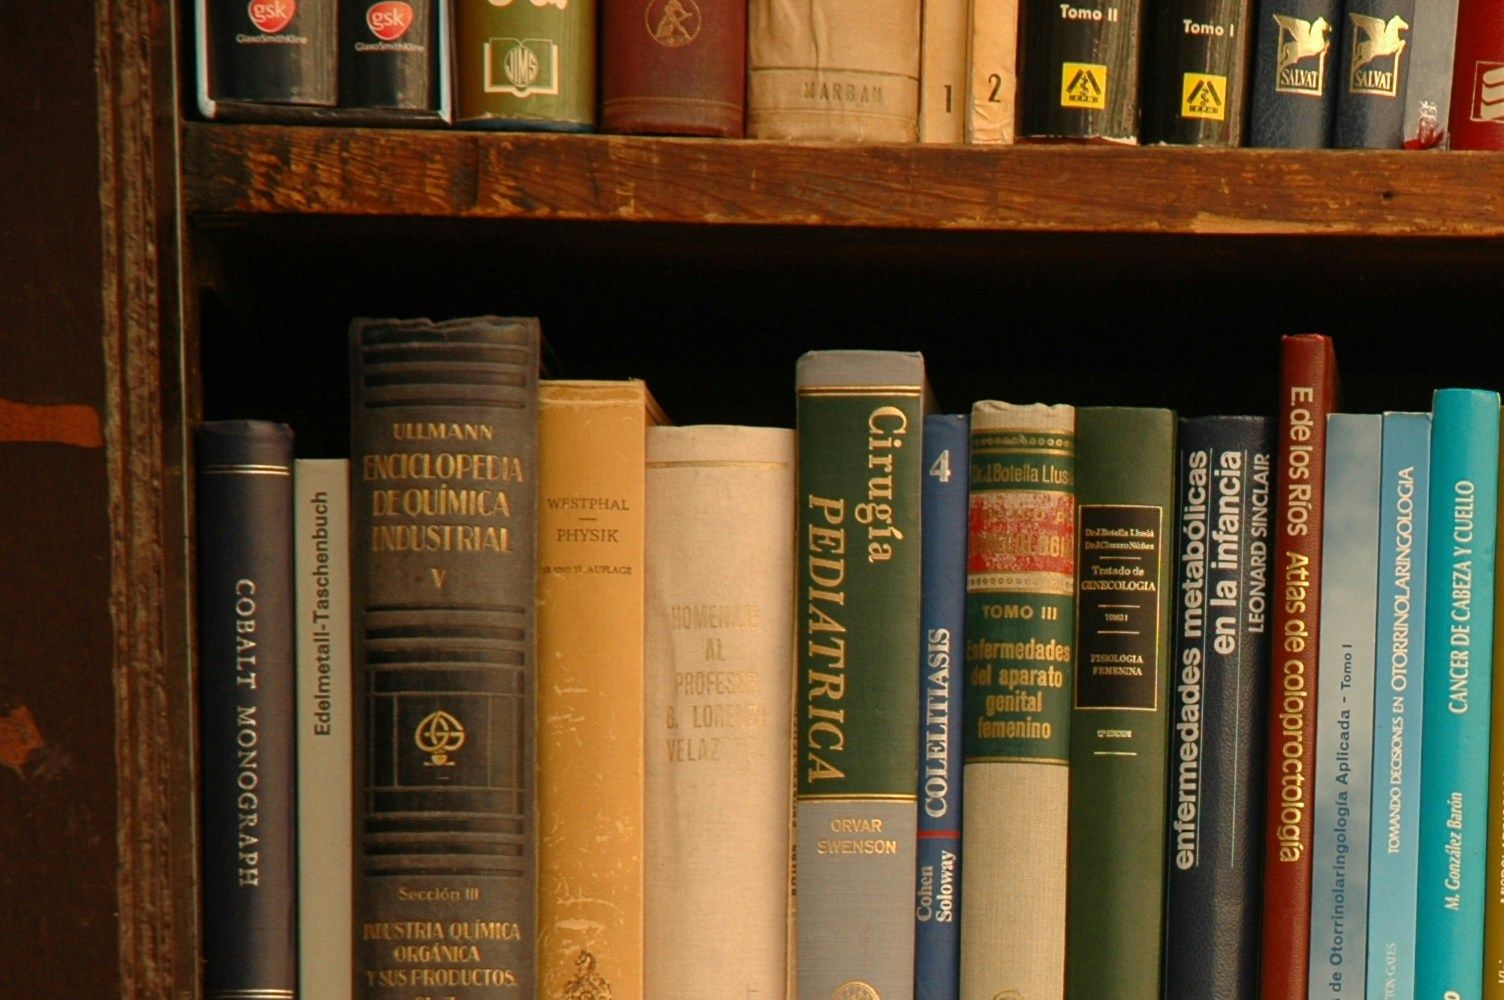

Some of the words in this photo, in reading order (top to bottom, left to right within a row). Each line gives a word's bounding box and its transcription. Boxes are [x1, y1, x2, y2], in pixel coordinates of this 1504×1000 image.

[253, 3, 286, 22] gsk
[371, 11, 403, 31] gsk
[1060, 4, 1102, 21] Tomo
[1183, 19, 1224, 36] Tomo
[988, 73, 1001, 103] 2
[1281, 68, 1319, 87] SALVAT
[1355, 69, 1393, 88] SALVAT
[855, 406, 907, 564] Cirugía
[1251, 453, 1270, 540] SINCLAIR
[1288, 445, 1312, 488] los
[546, 497, 630, 512] WESTPHAL
[1211, 450, 1242, 571] infancia
[1287, 489, 1312, 537] Ríos
[1454, 480, 1475, 543] CUELLO
[372, 525, 511, 553] INDUSTRIAL
[1183, 450, 1208, 638] metabólicas
[1081, 580, 1156, 592] GINECOLOGIA
[1248, 545, 1267, 633] LEONARD
[1285, 551, 1310, 614] Atlas
[1390, 466, 1414, 691] OTORRINOLARINGOLOGIA
[1452, 560, 1473, 620] CABEZA
[233, 579, 256, 689] COBALT
[807, 495, 847, 783] PEDIATRICA
[999, 666, 1063, 688] aparato
[1340, 651, 1353, 689] Tomo
[1449, 647, 1470, 715] CANCER
[977, 714, 1051, 739] femenino
[986, 690, 1042, 713] genital
[1175, 646, 1201, 871] enfermedades
[1277, 660, 1306, 863] coloproctología
[1339, 709, 1351, 785] Aplicada
[1391, 718, 1403, 784] DECISIONES
[235, 706, 260, 888] MONOGRAPH
[1388, 787, 1400, 854] TOMANDO
[1446, 791, 1463, 827] Barón
[817, 839, 897, 855] SWENSON
[1330, 789, 1350, 963] Otorrinolaringología
[1444, 830, 1462, 892] González
[398, 887, 460, 902] Sección
[916, 865, 934, 922] Cohen
[935, 850, 957, 923] Soloway
